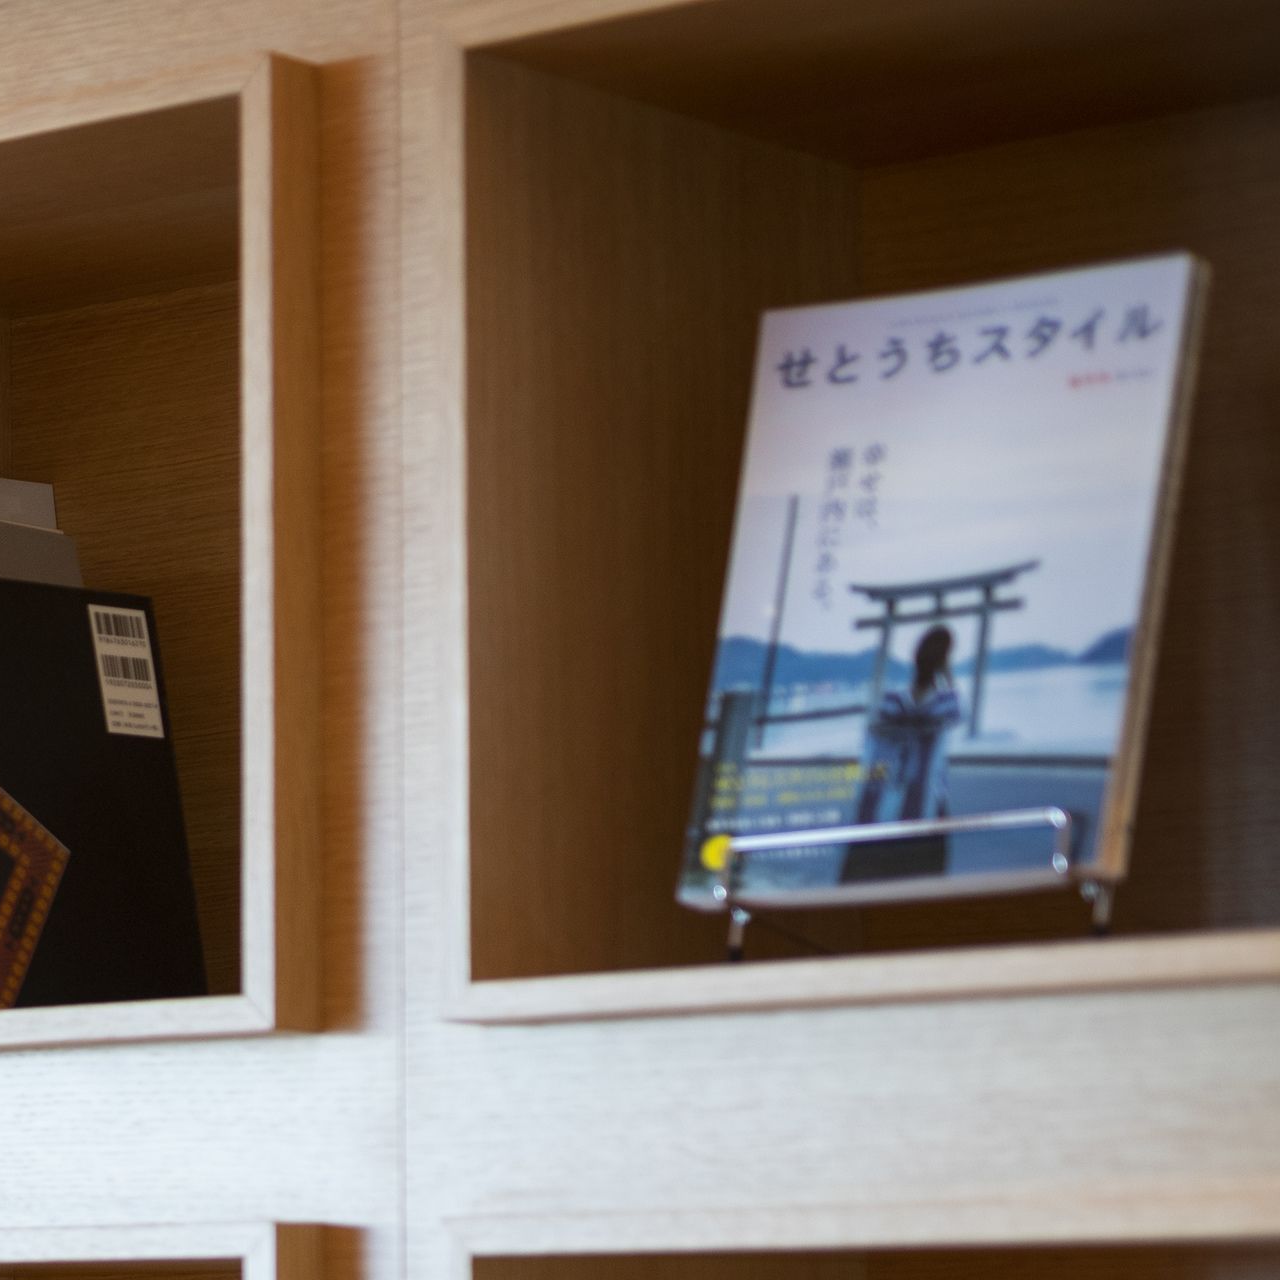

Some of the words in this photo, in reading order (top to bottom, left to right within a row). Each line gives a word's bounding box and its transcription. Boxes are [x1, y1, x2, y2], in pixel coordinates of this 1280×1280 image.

[775, 305, 1164, 391] せとうちスタイル
